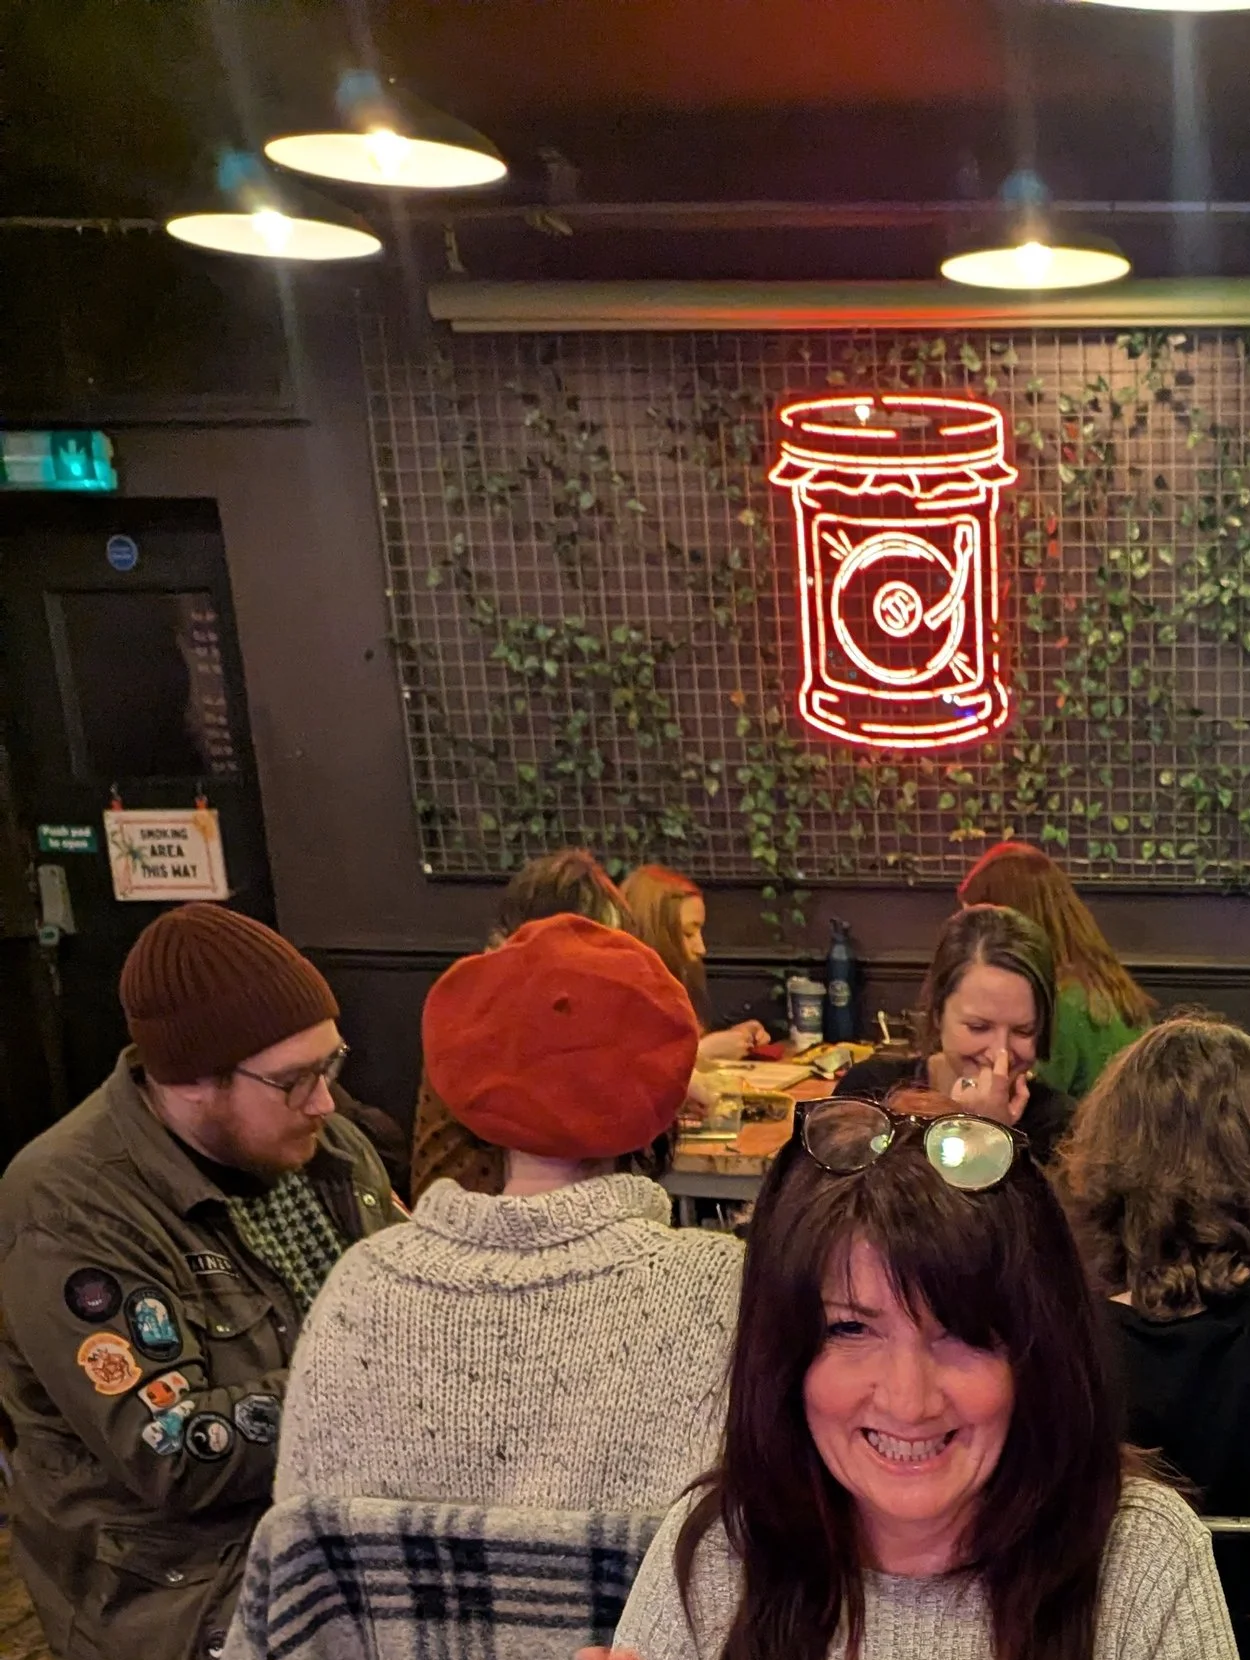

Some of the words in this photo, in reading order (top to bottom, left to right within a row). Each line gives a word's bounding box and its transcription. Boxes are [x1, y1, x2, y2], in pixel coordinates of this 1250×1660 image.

[140, 828, 189, 841] SMOKING
[150, 844, 185, 858] AREA
[141, 864, 169, 879] THIS
[172, 864, 197, 879] WAY
